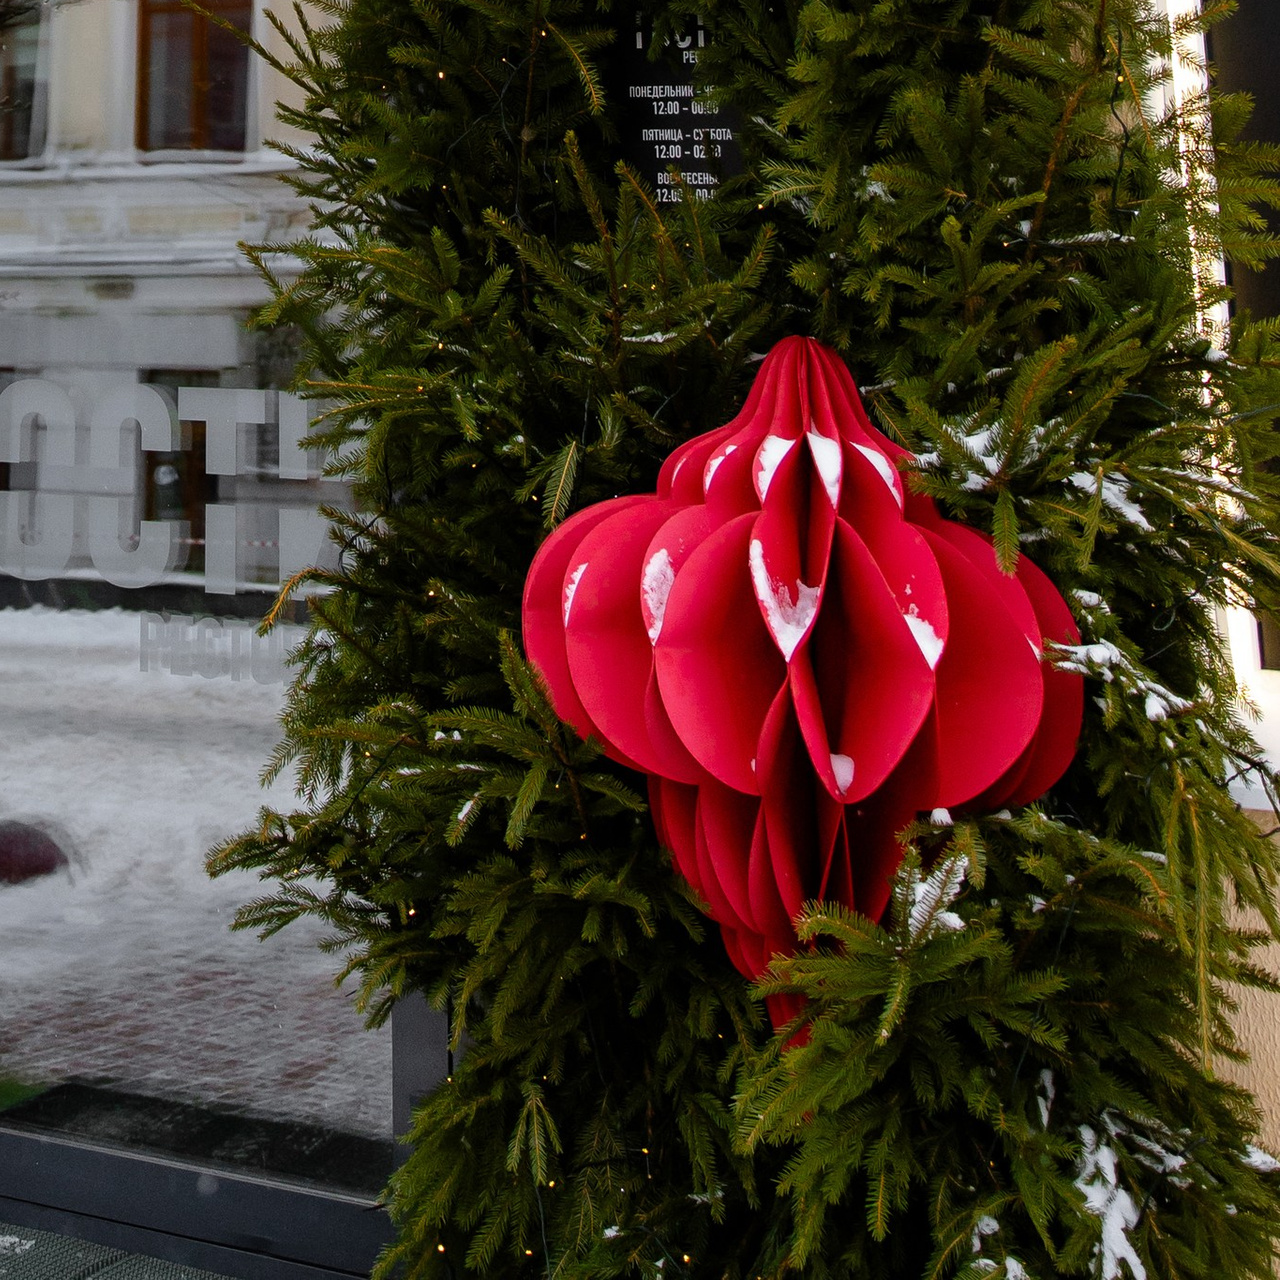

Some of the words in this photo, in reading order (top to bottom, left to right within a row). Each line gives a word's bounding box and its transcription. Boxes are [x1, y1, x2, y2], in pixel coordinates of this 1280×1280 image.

[629, 85, 694, 99] ПОНЕДЕЛЬНИК
[652, 101, 680, 115] 12:00
[642, 128, 683, 142] ПЯТНИЦА
[693, 128, 733, 141] СУБОТА
[654, 145, 682, 159] 12:00
